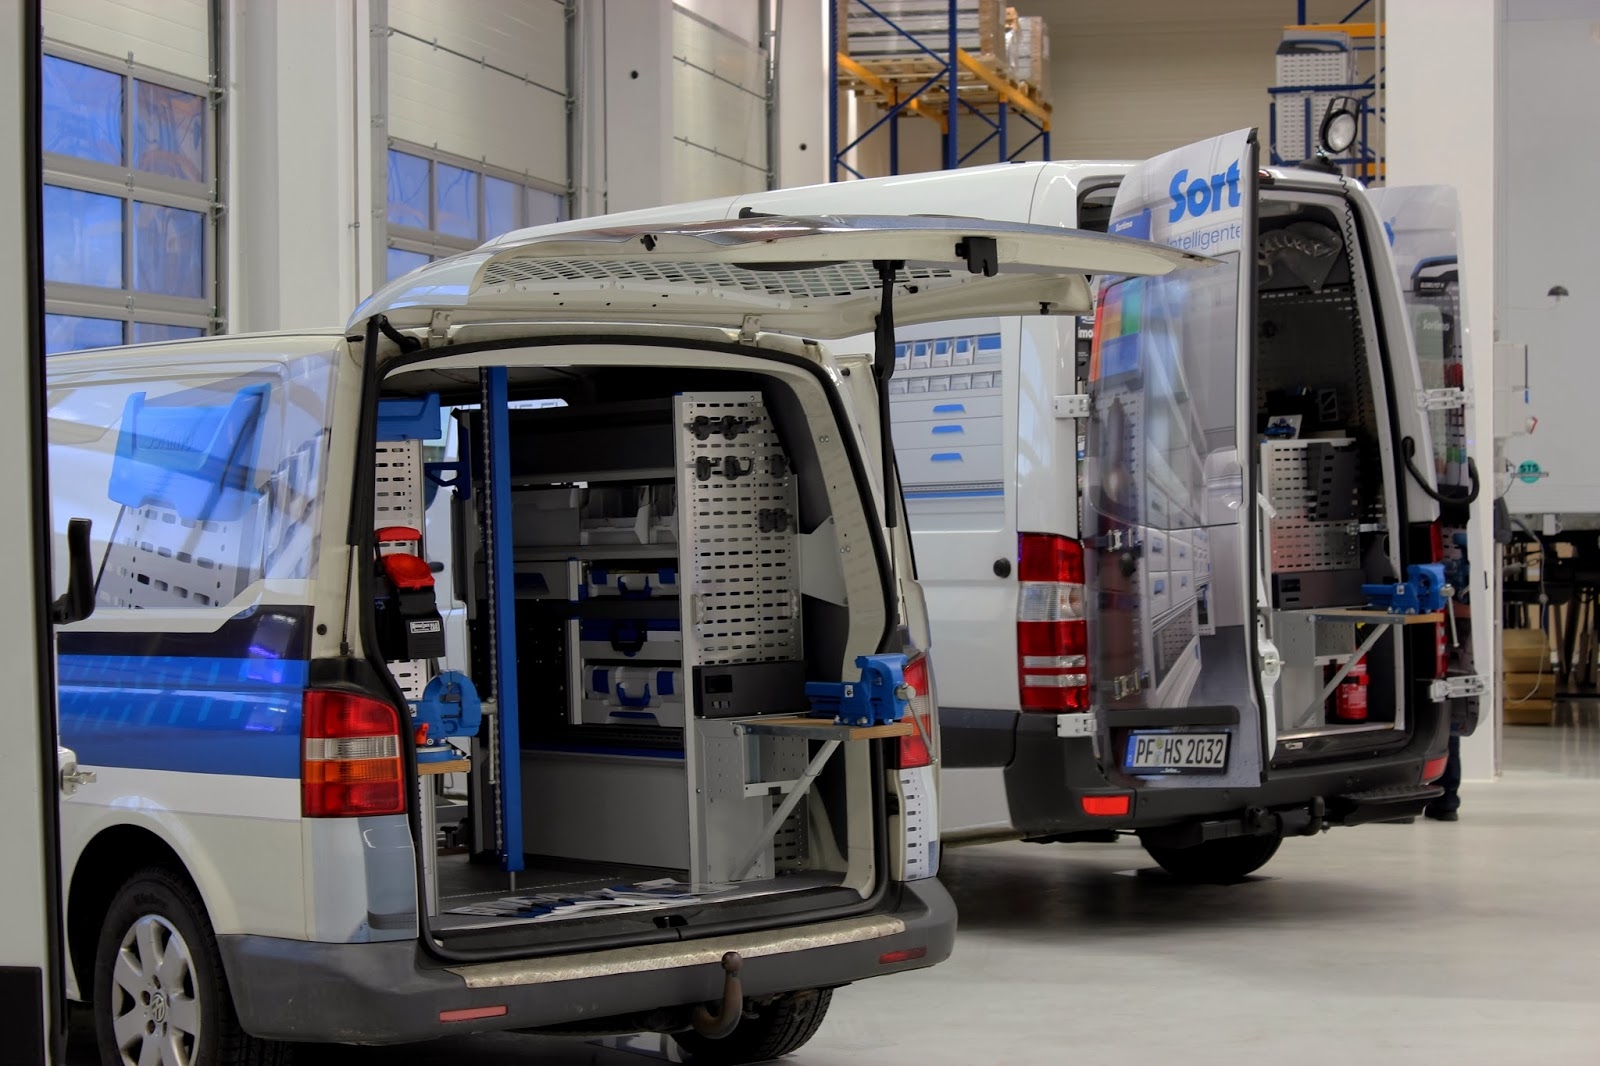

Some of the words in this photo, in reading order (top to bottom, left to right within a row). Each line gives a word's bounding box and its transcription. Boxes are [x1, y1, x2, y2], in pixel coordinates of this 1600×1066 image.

[1169, 160, 1240, 223] Sort
[1136, 739, 1155, 763] PF
[1163, 739, 1183, 763] HS
[1186, 739, 1224, 763] 2032
